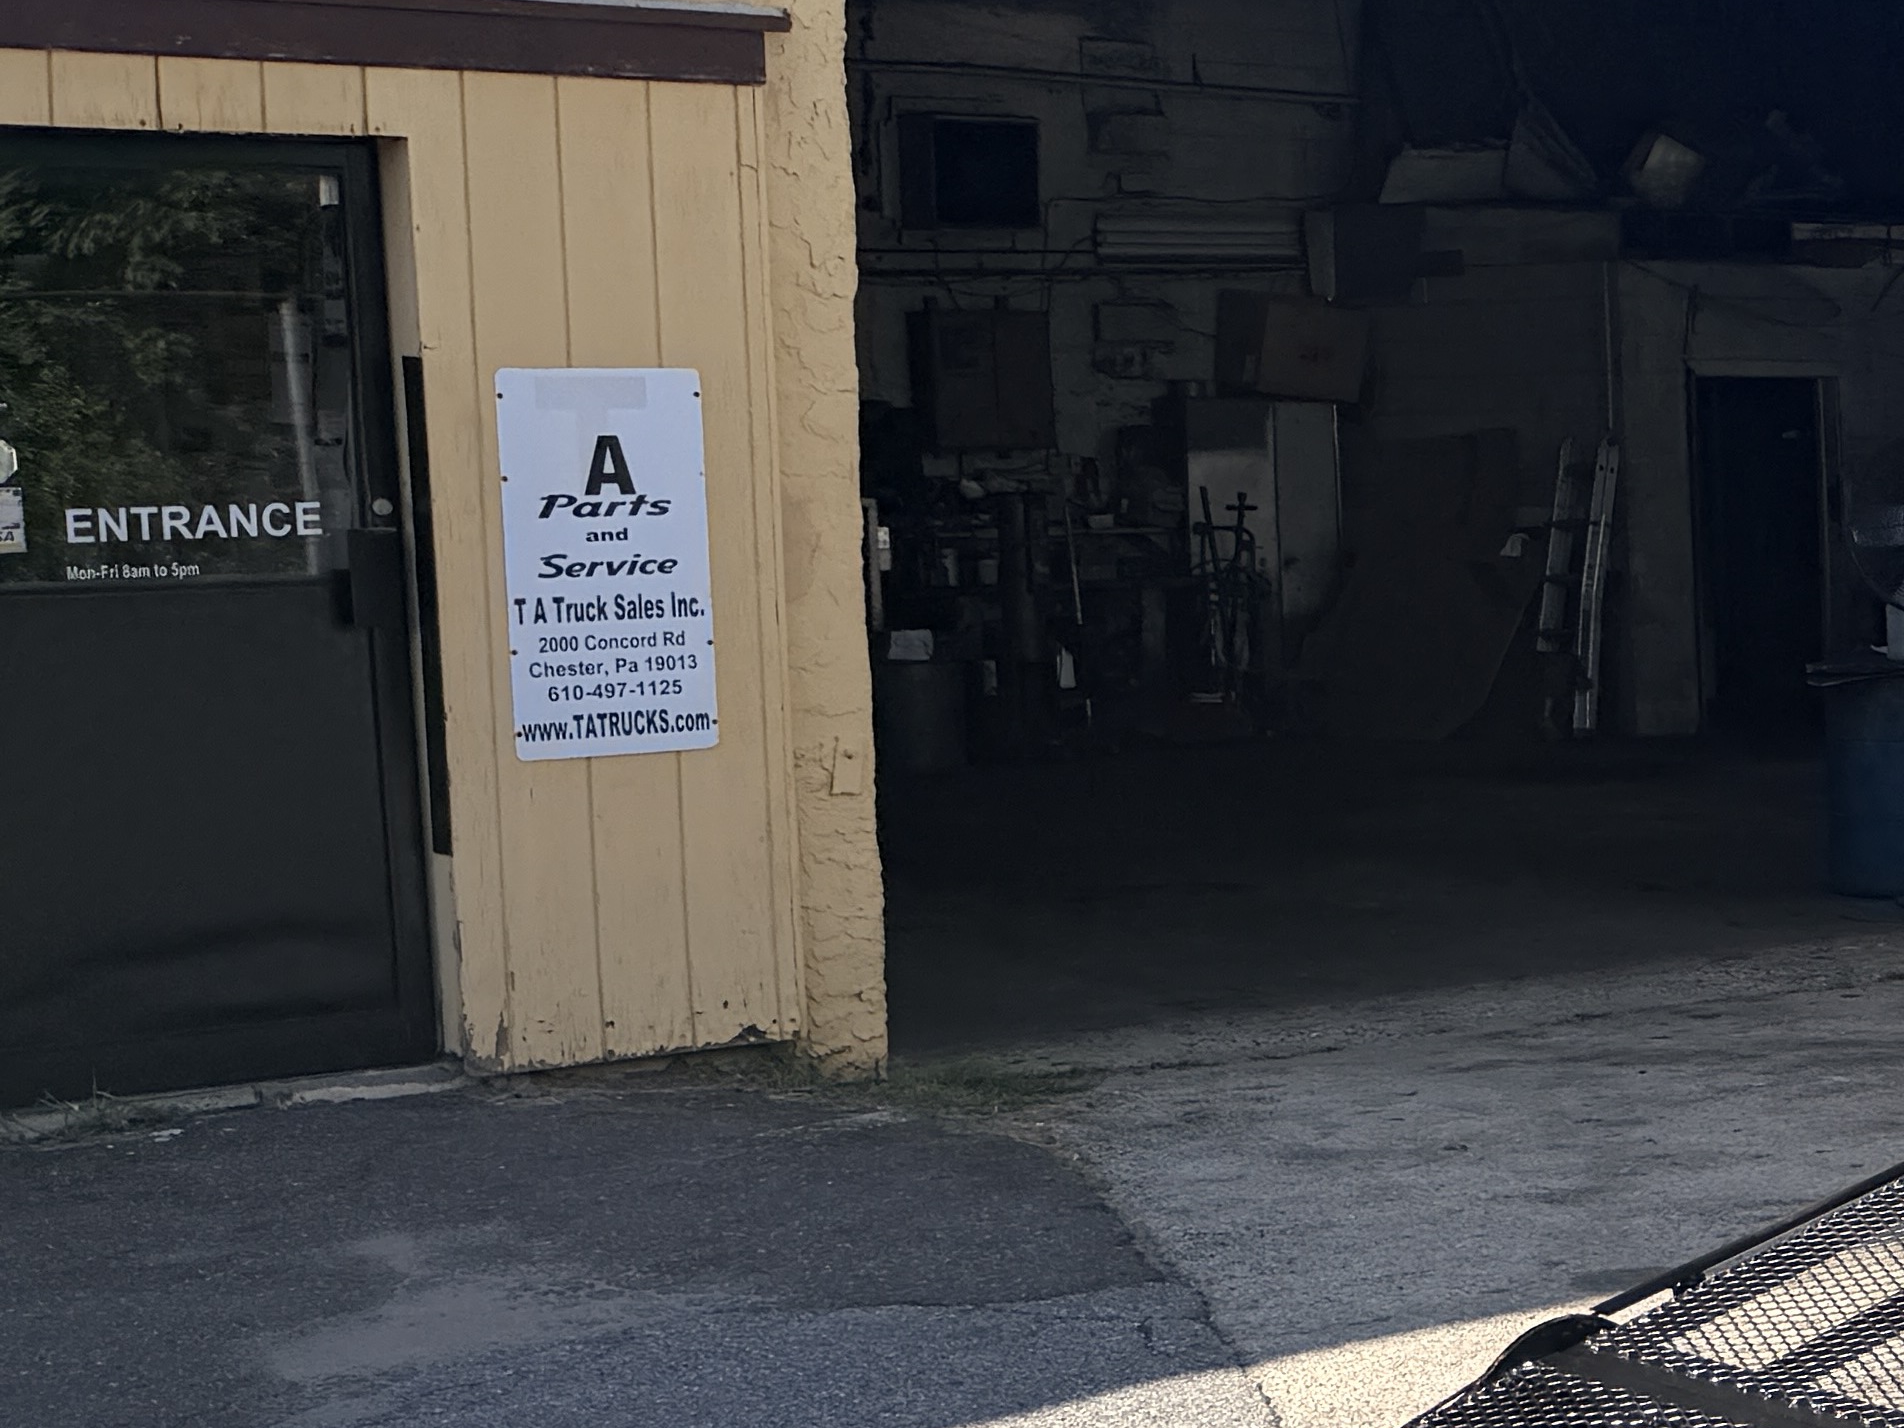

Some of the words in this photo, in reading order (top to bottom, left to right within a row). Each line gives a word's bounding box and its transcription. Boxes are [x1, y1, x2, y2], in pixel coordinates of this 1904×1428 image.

[538, 493, 673, 519] Parts
[65, 501, 323, 545] ENTRANCE
[585, 527, 629, 543] and
[66, 564, 119, 581] Mon-Fri
[122, 564, 151, 579] 8am
[154, 563, 168, 578] to
[171, 562, 201, 581] 5pm
[537, 553, 679, 579] Service
[513, 598, 526, 625] T
[533, 597, 548, 624] A
[552, 594, 609, 624] Truck
[614, 593, 665, 621] Sales
[671, 591, 705, 619] Inc.
[538, 635, 579, 654] 2000
[584, 632, 657, 652] Concord
[663, 630, 686, 647] Rd
[529, 659, 609, 679] Chester,
[615, 657, 639, 674] Pa
[645, 654, 698, 672] 19013
[548, 679, 684, 703] 610-497-1125
[522, 709, 710, 742] www.TATRUCKS.com
